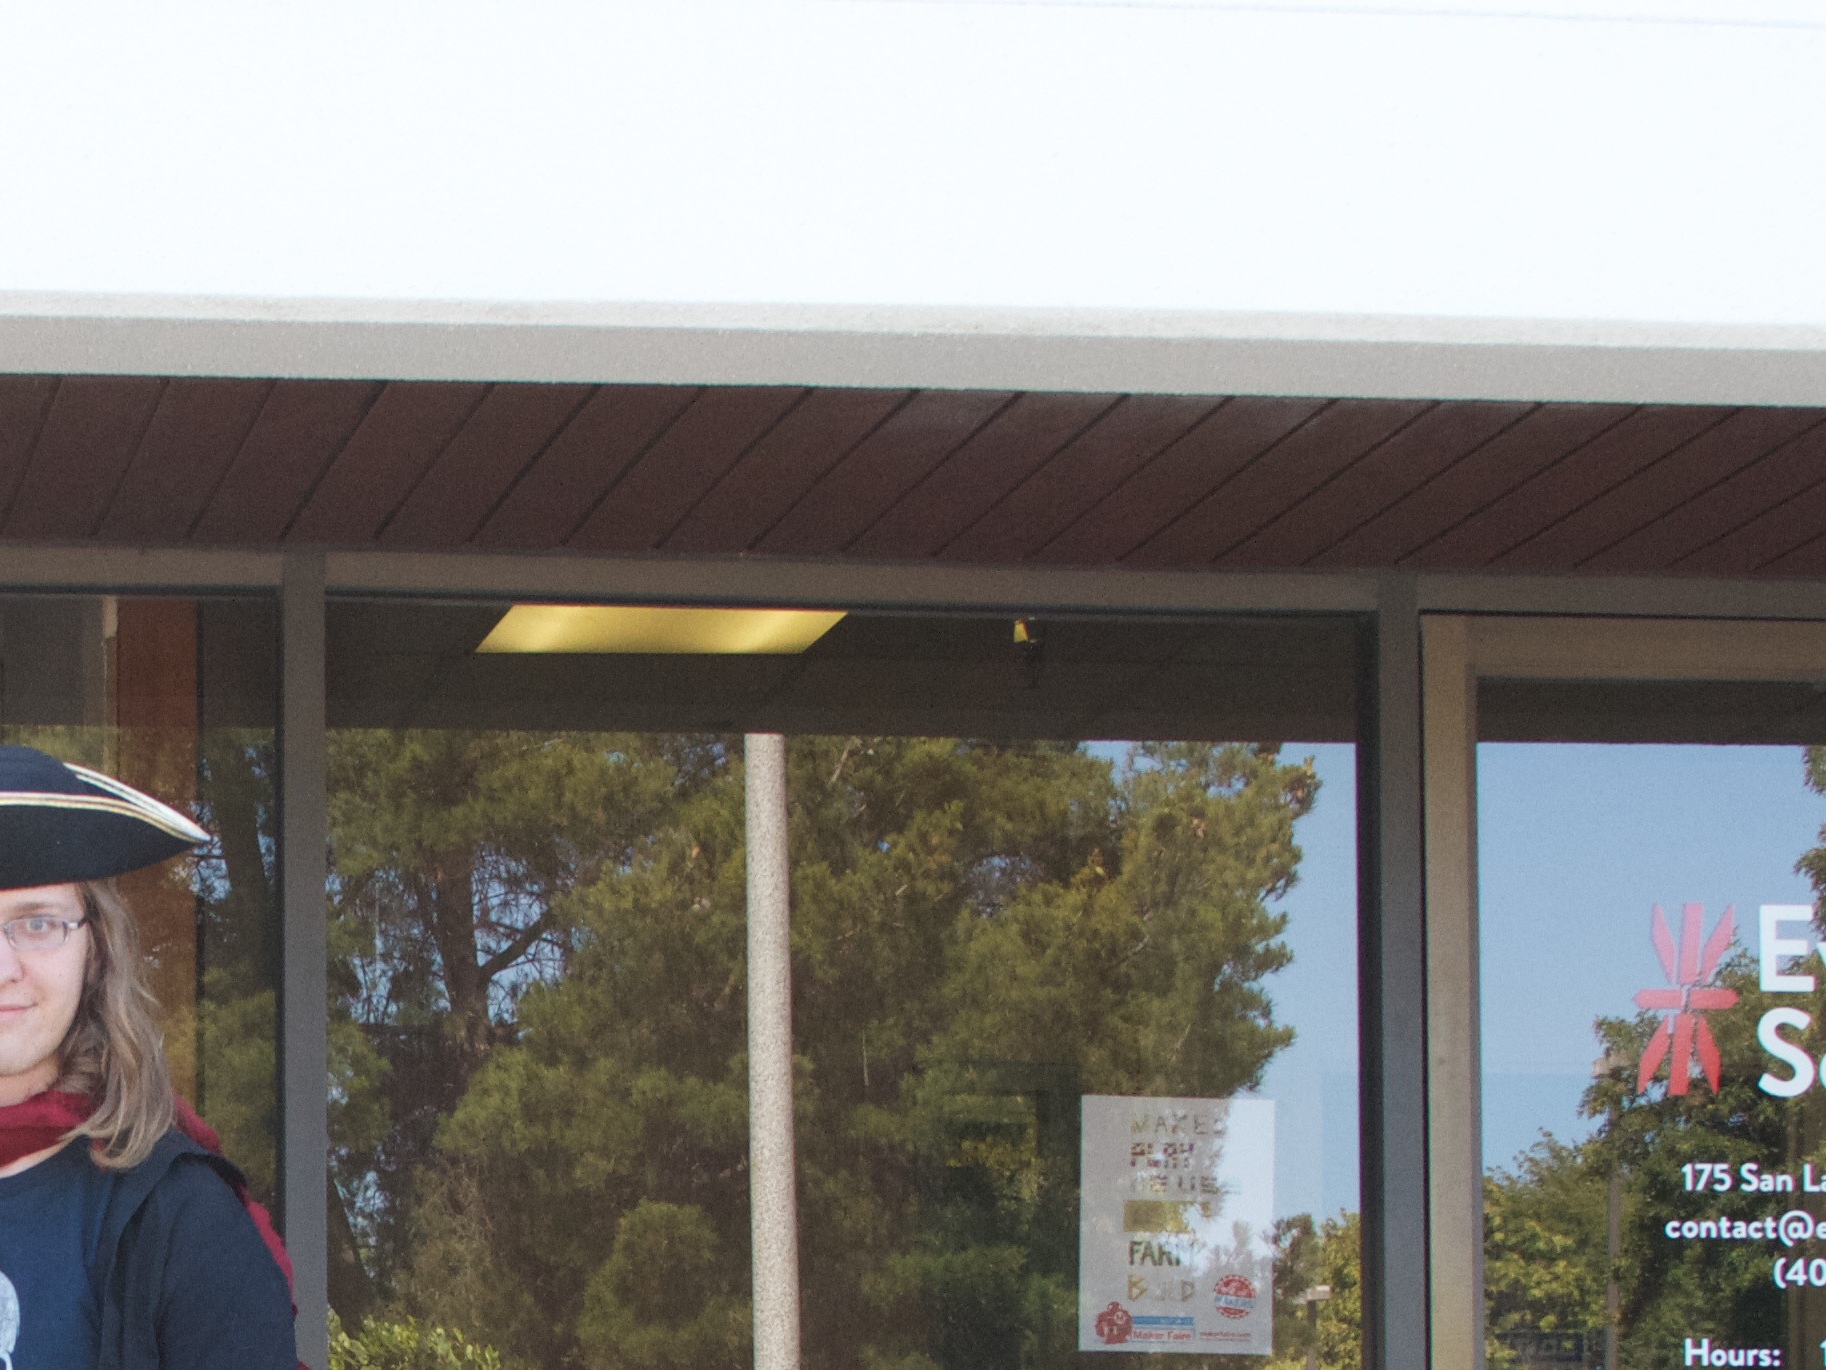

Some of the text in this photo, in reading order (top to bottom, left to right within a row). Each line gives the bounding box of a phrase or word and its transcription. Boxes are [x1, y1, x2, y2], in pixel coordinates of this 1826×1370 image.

[1757, 1006, 1826, 1098] S
[1681, 1162, 1733, 1192] 175
[1739, 1162, 1794, 1193] San
[1684, 1337, 1781, 1368] Hours:
